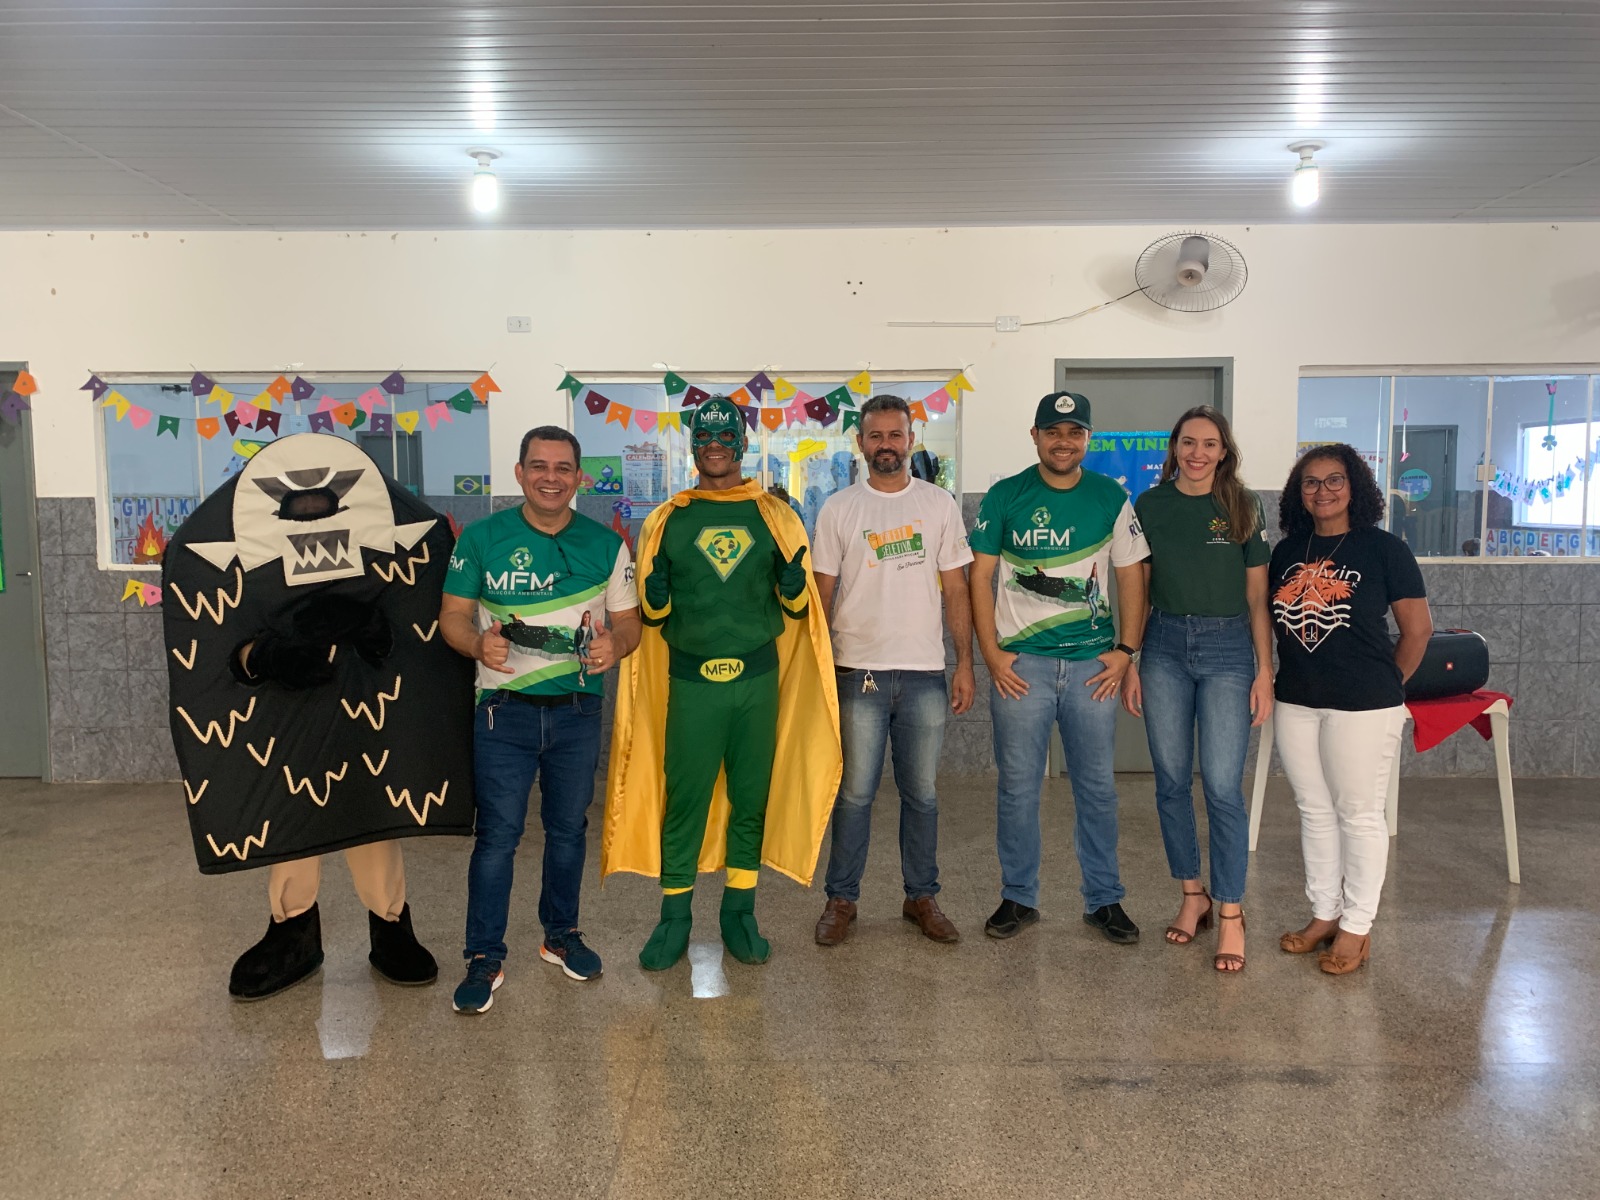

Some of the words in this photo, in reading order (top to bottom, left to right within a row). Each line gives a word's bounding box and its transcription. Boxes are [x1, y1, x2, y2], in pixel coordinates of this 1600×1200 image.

[700, 411, 729, 421] MFM
[1089, 439, 1116, 452] EM
[123, 499, 132, 516] G
[137, 499, 147, 515] H
[155, 499, 159, 515] I
[168, 499, 174, 515] J
[180, 499, 189, 515] K
[1013, 529, 1070, 546] MFM
[1487, 530, 1494, 543] A
[1500, 531, 1508, 544] B
[1513, 532, 1521, 545] C
[1527, 532, 1535, 546] D
[1541, 533, 1549, 547] E
[1556, 534, 1563, 548] F
[1570, 534, 1579, 549] G
[883, 541, 912, 556] SELETIVA
[486, 571, 554, 591] MFM
[1322, 579, 1358, 588] YORK
[705, 661, 741, 676] MFM
